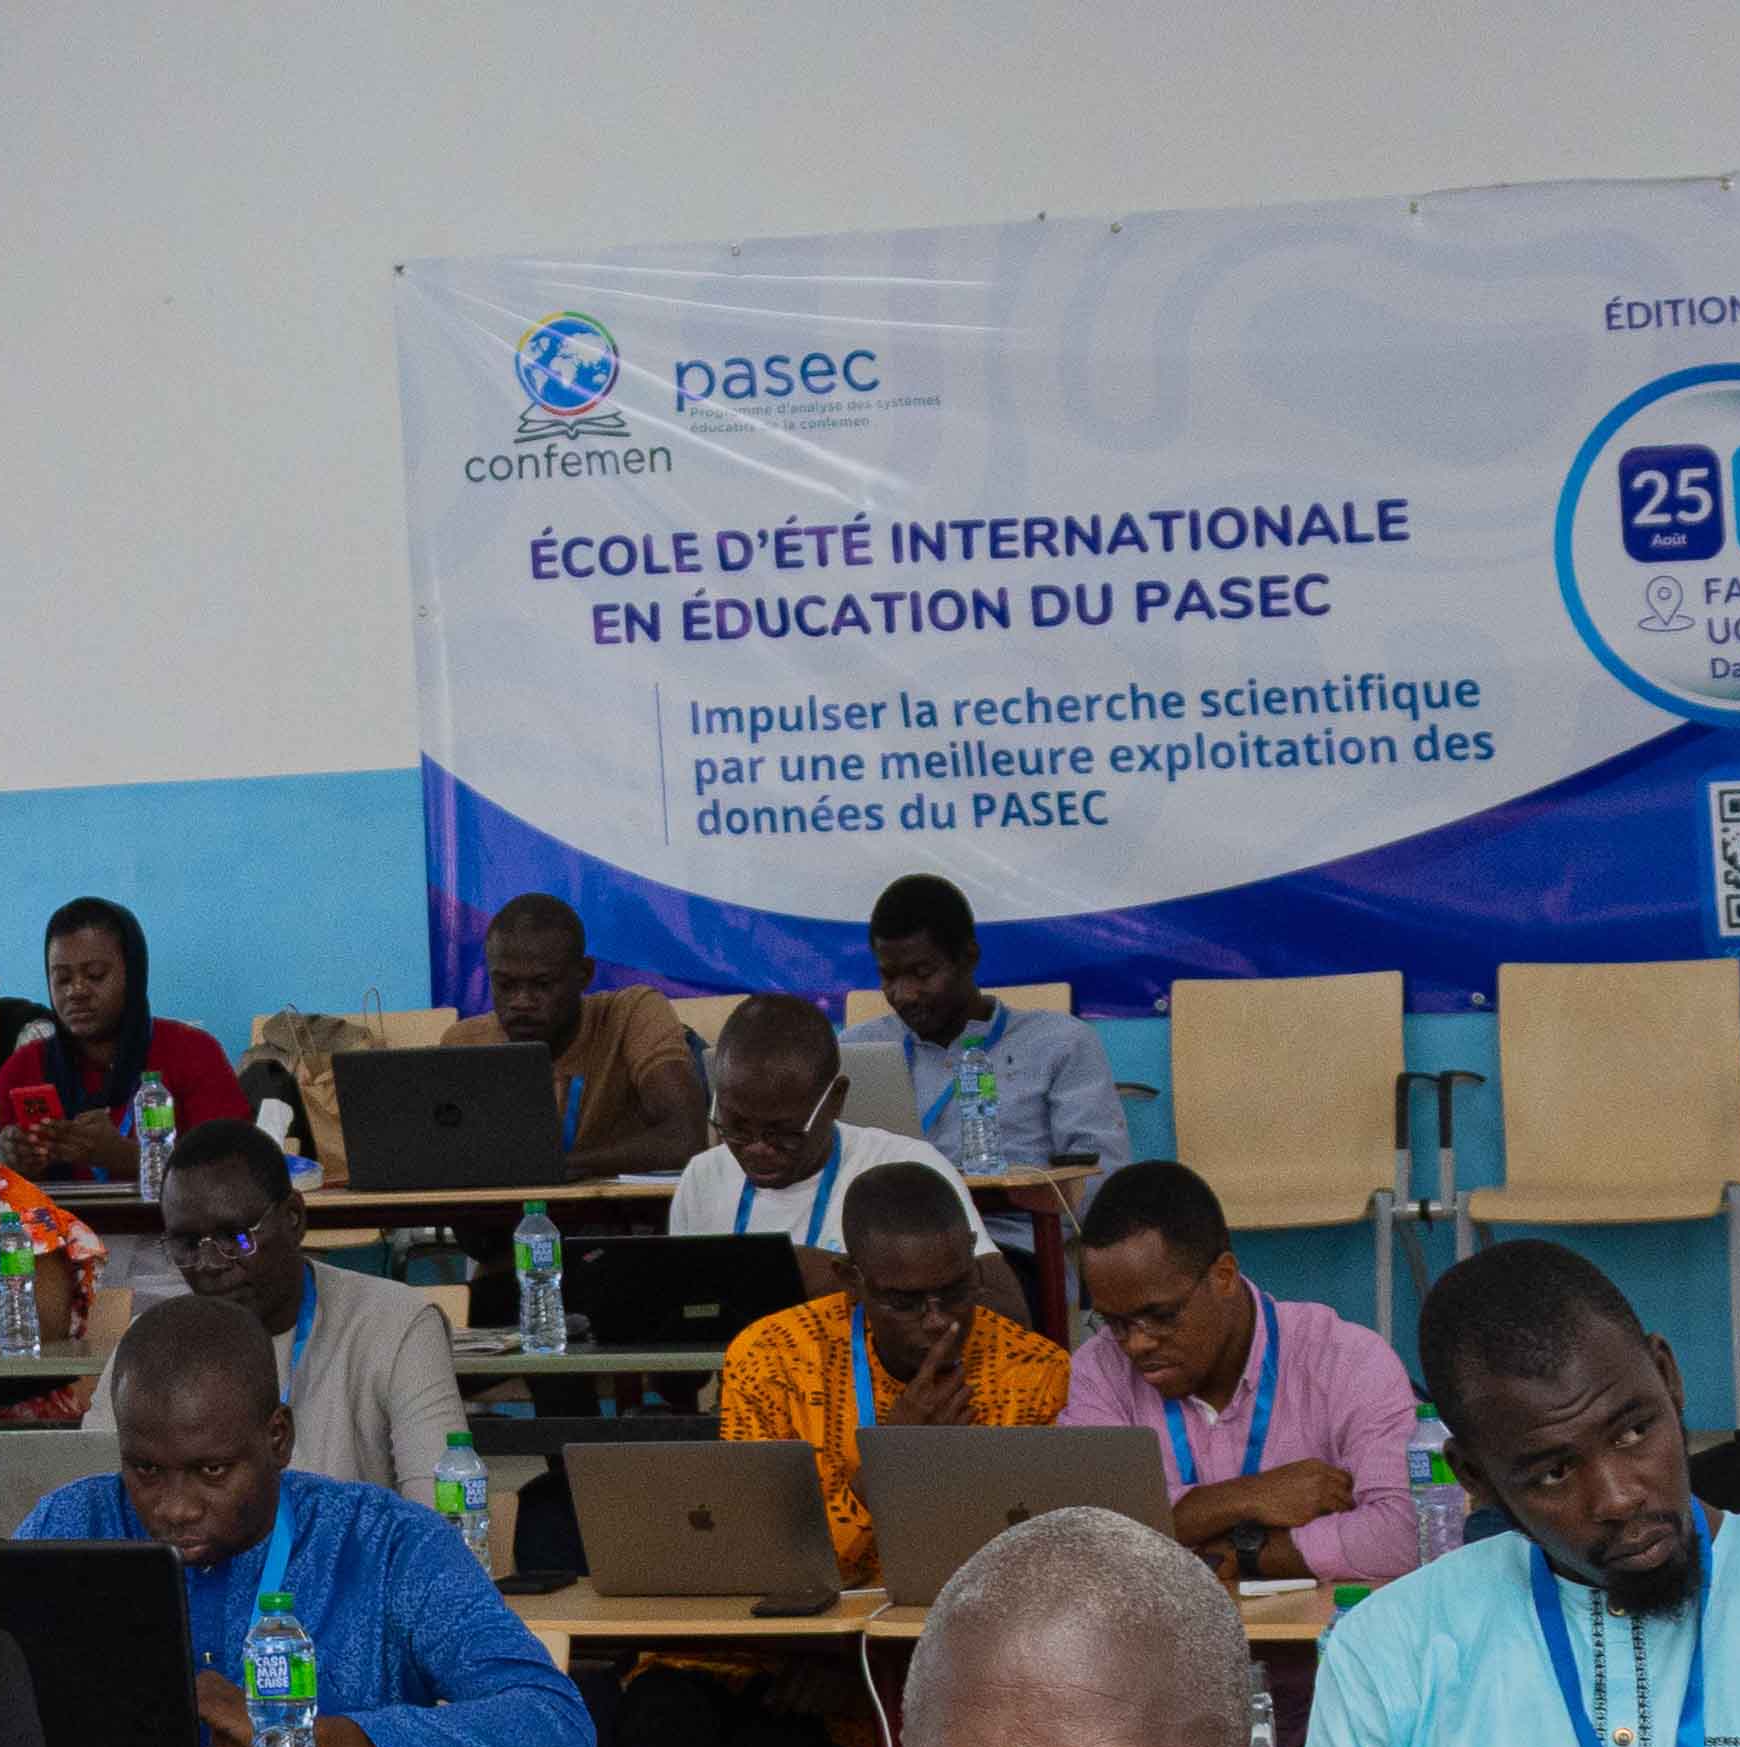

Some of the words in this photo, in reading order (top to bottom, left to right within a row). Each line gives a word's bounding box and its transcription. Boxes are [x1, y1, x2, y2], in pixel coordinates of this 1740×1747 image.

[674, 349, 880, 412] pasec
[465, 444, 672, 483] confemen
[1631, 468, 1713, 526] 25
[530, 527, 703, 580] ÉCOLE
[891, 498, 1411, 565] INTERNATIONALE
[1651, 532, 1687, 547] Août
[592, 601, 661, 645] EN
[683, 587, 1011, 641] ÉDUCATION
[1030, 582, 1113, 628] DU
[1136, 573, 1331, 622] PASEC
[689, 694, 887, 744] Impulser
[900, 691, 938, 729] la
[954, 682, 1186, 728] recherche
[1200, 672, 1481, 721] scientifique
[694, 756, 766, 796] par
[780, 753, 865, 782] une
[881, 740, 1095, 780] meilleure
[1109, 727, 1397, 782] exploitation
[1413, 723, 1496, 763] des
[697, 795, 885, 836] données
[900, 793, 956, 830] du
[973, 789, 1109, 829] PASEC
[255, 1655, 288, 1667] CASA
[256, 1667, 288, 1679] MAN
